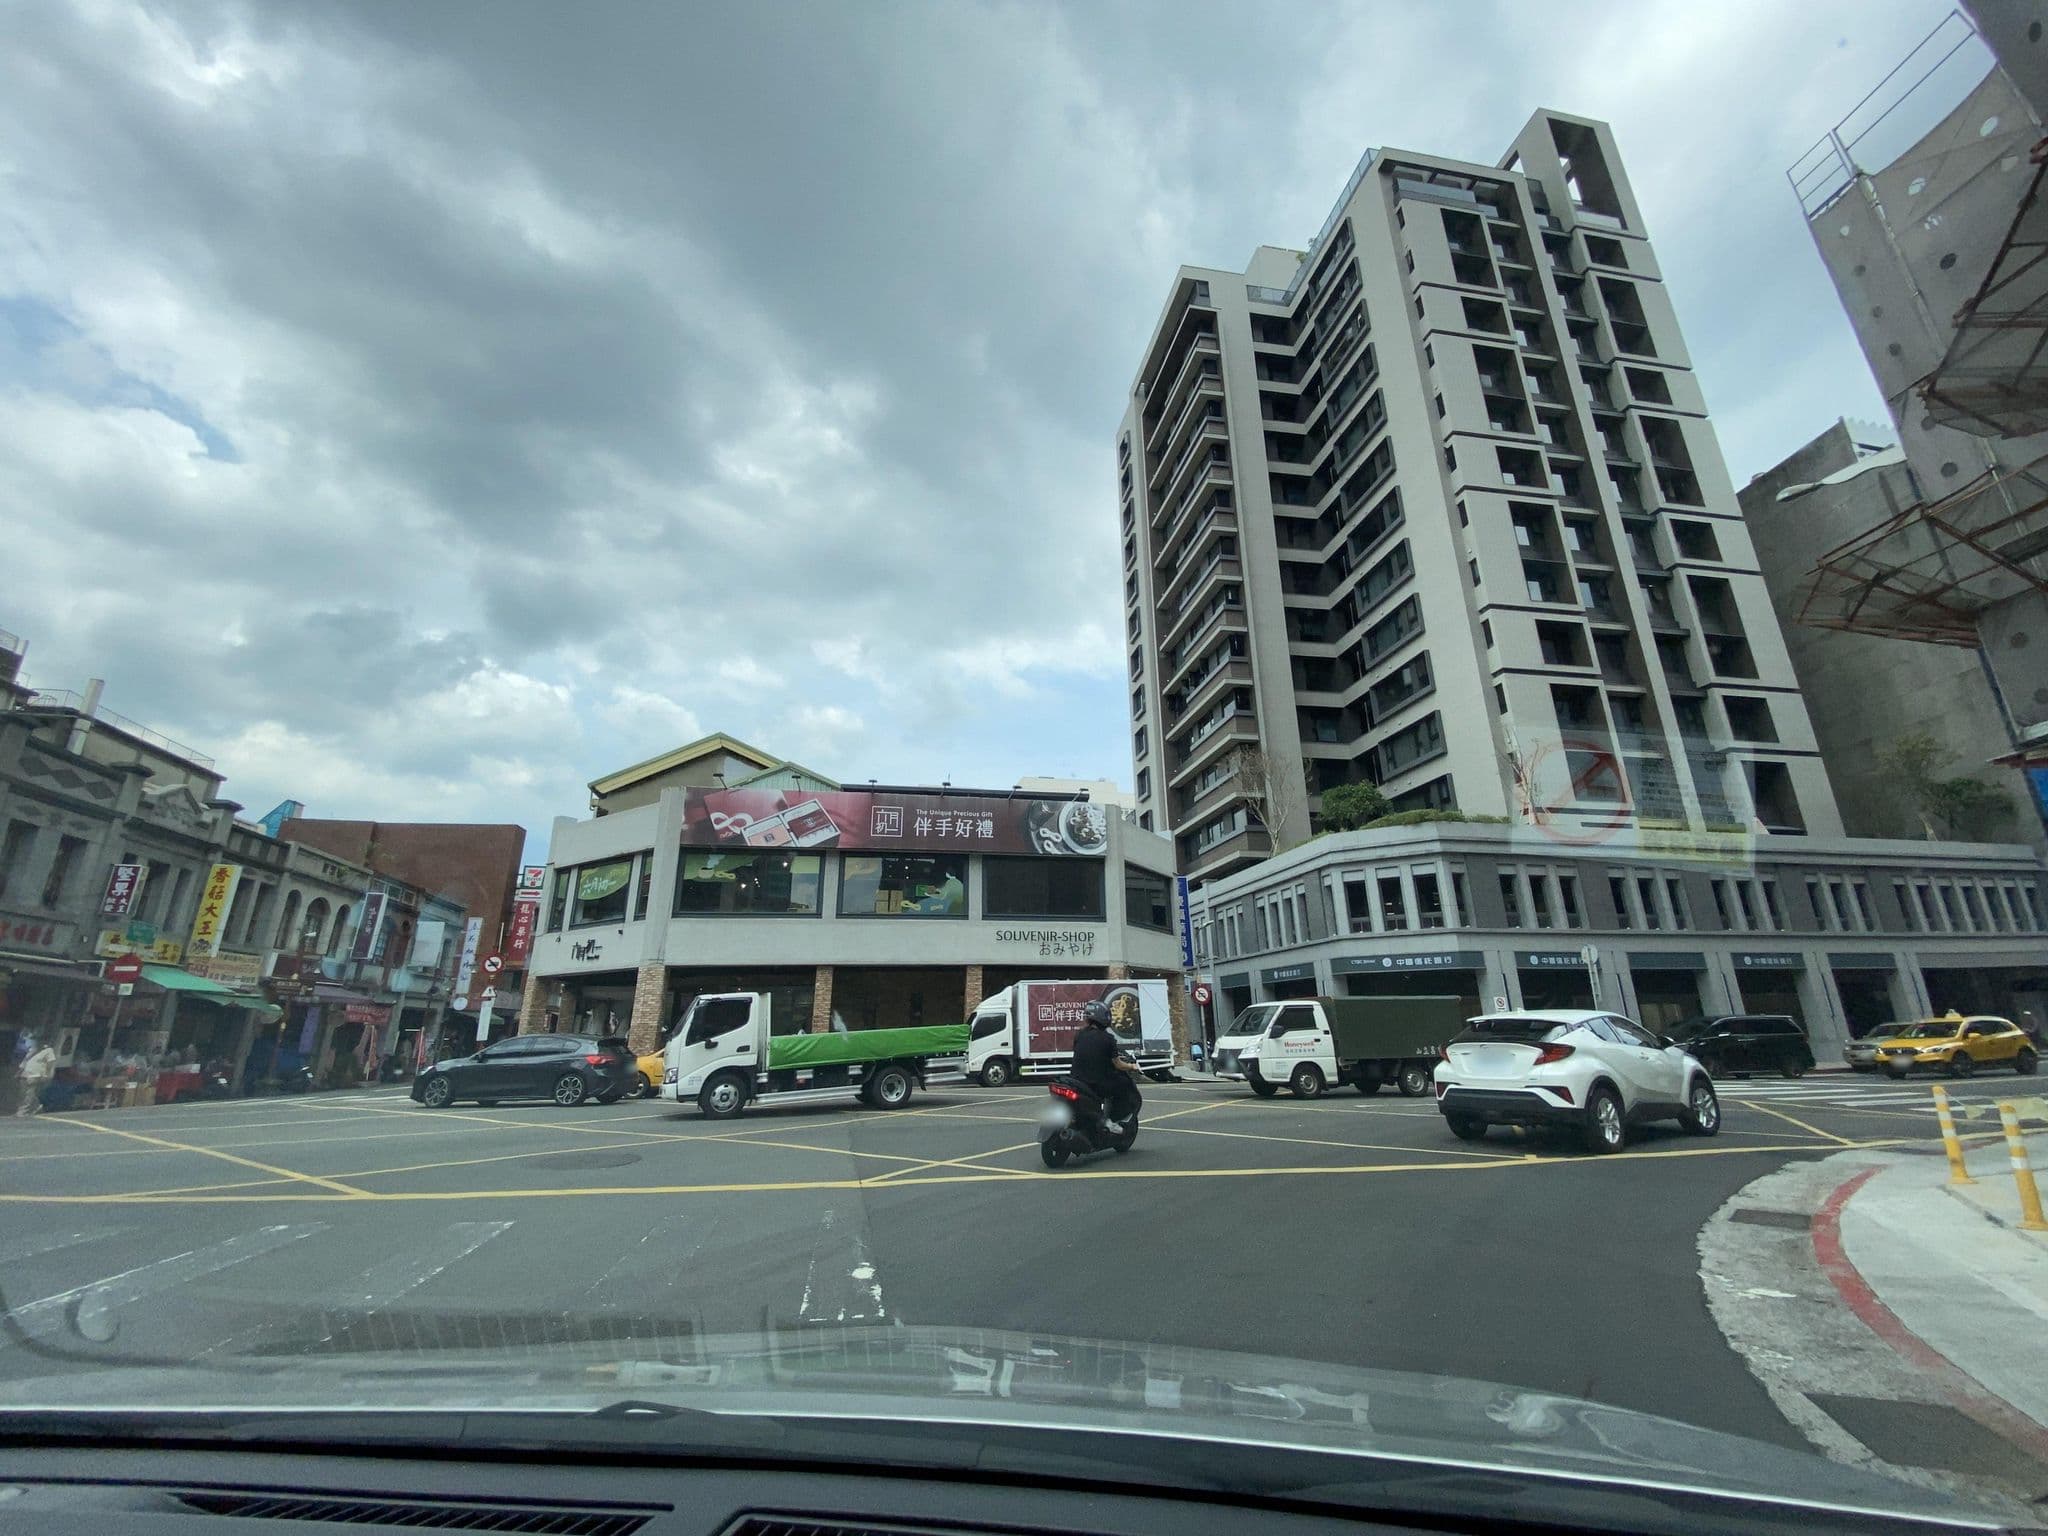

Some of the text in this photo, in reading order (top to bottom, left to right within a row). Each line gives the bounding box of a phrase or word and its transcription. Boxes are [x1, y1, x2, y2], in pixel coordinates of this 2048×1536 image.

[916, 808, 928, 816] The
[929, 809, 952, 817] Unique
[953, 810, 980, 818] Precious
[913, 817, 994, 839] 伴手好禮
[112, 866, 135, 897] 堅果
[995, 930, 1095, 942] SOUVENIR-SHOP
[1039, 941, 1094, 956] おみやげ
